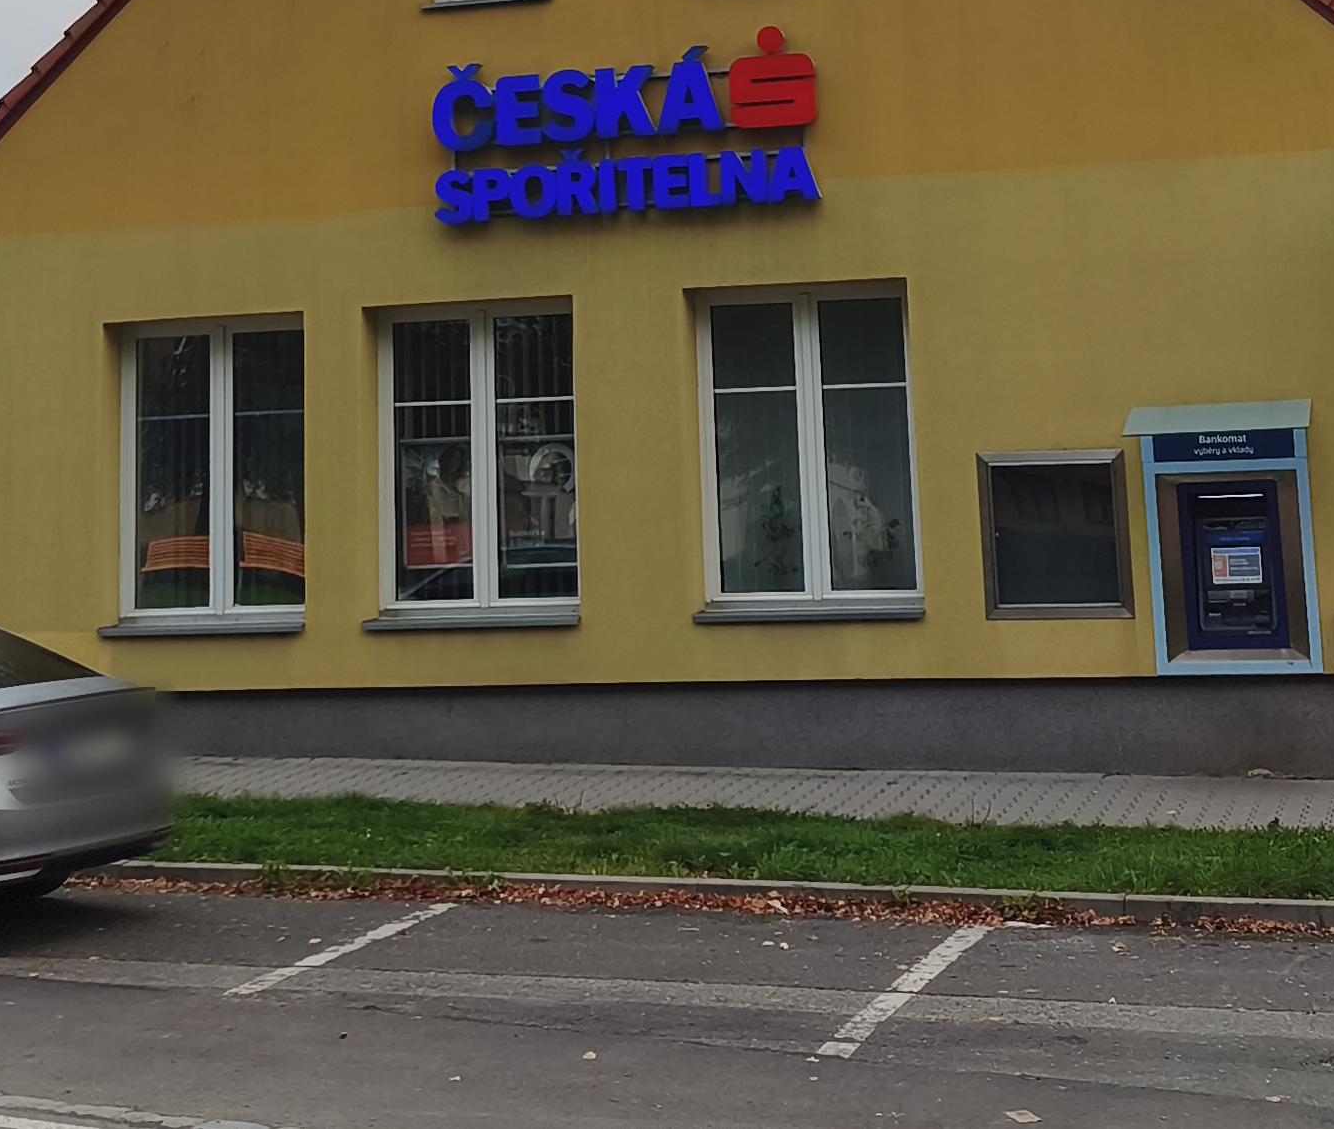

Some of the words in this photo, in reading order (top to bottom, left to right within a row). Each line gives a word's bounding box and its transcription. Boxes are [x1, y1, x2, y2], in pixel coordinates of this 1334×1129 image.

[432, 46, 724, 151] ČESKÁ
[434, 148, 821, 226] SPOŘITELNA
[1198, 434, 1247, 444] Bankomat
